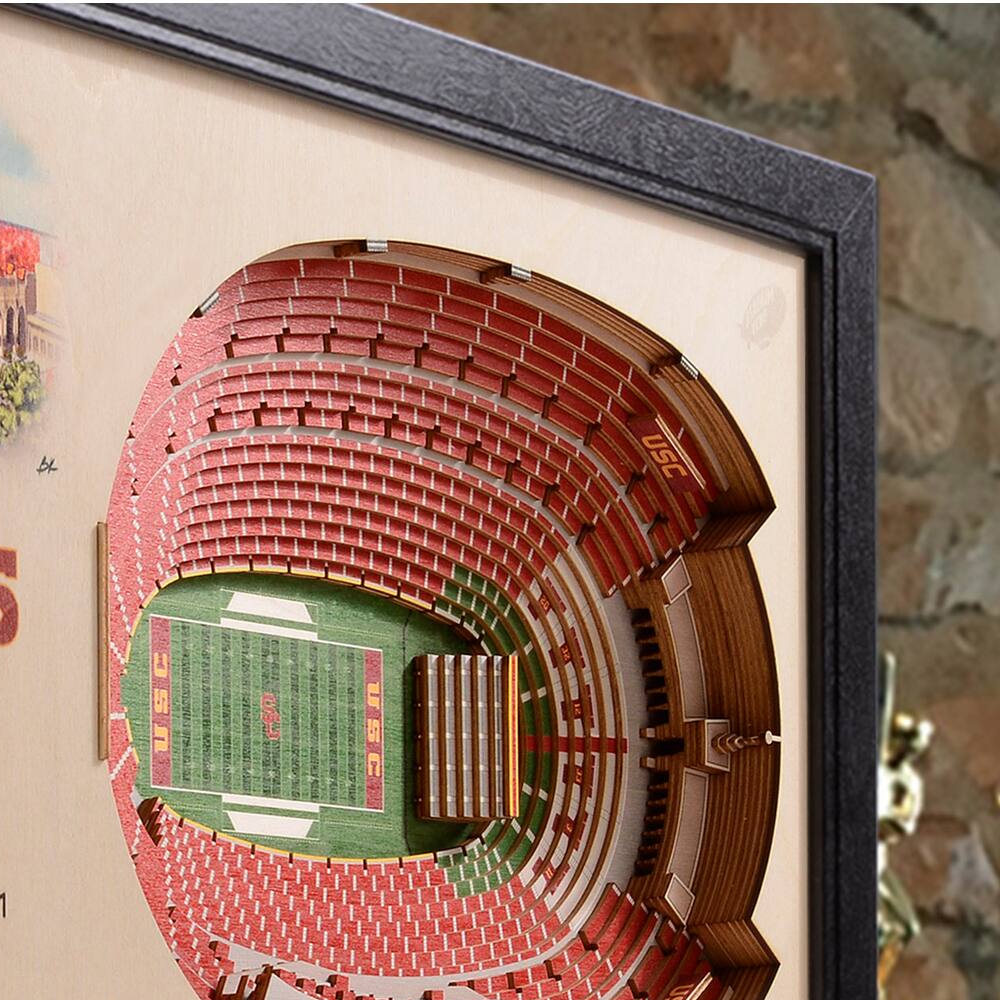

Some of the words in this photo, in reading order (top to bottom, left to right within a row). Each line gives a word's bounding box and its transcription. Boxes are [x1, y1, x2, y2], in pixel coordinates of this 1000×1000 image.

[641, 433, 688, 479] USC
[153, 652, 170, 753] USC
[365, 681, 382, 778] USC
